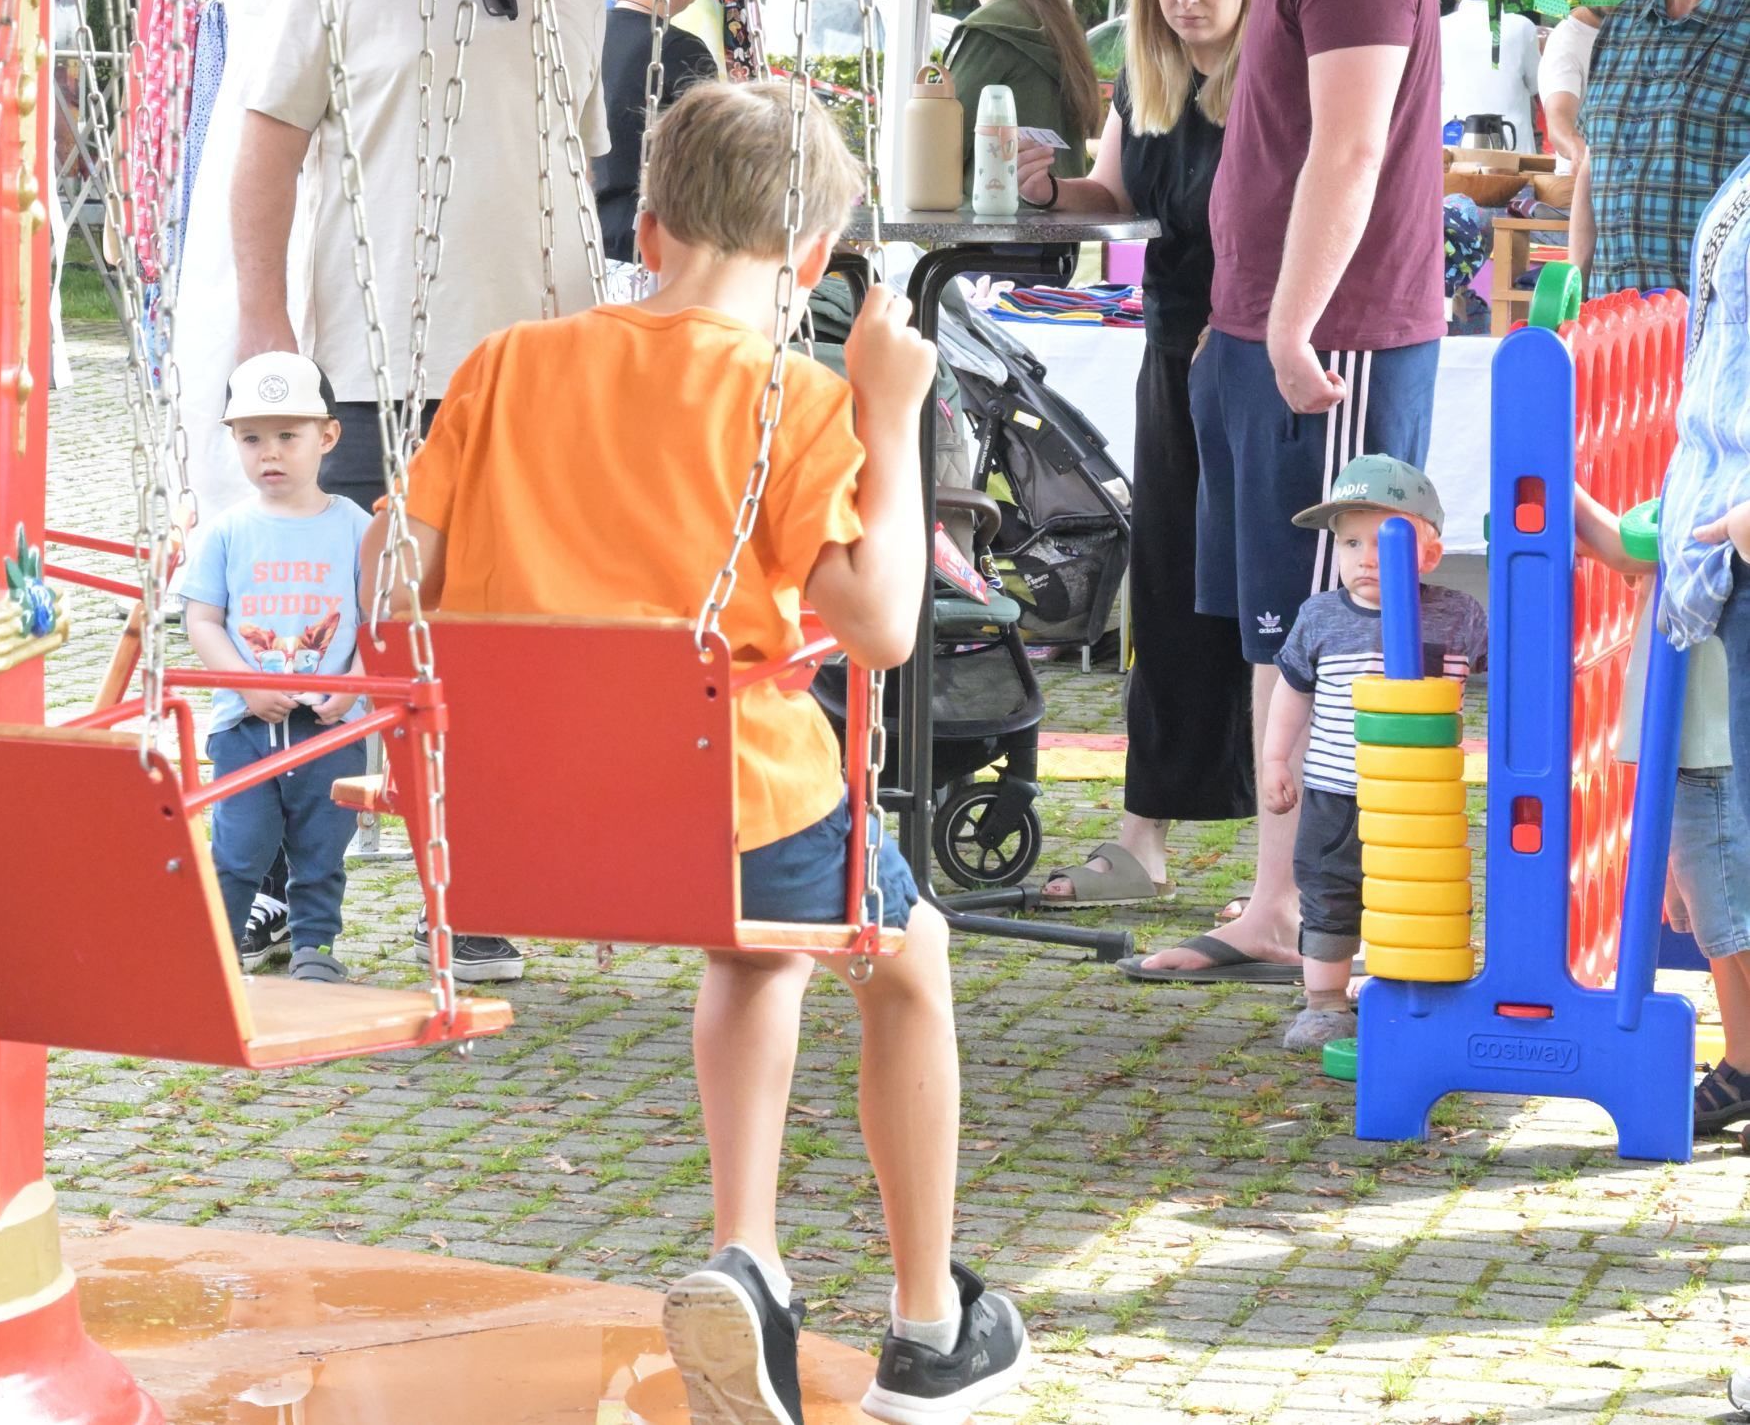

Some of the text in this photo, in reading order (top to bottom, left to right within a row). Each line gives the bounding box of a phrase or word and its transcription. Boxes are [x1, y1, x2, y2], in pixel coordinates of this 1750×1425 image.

[252, 560, 332, 584] SURF
[241, 594, 343, 618] BUDDY
[1258, 626, 1283, 634] adidas
